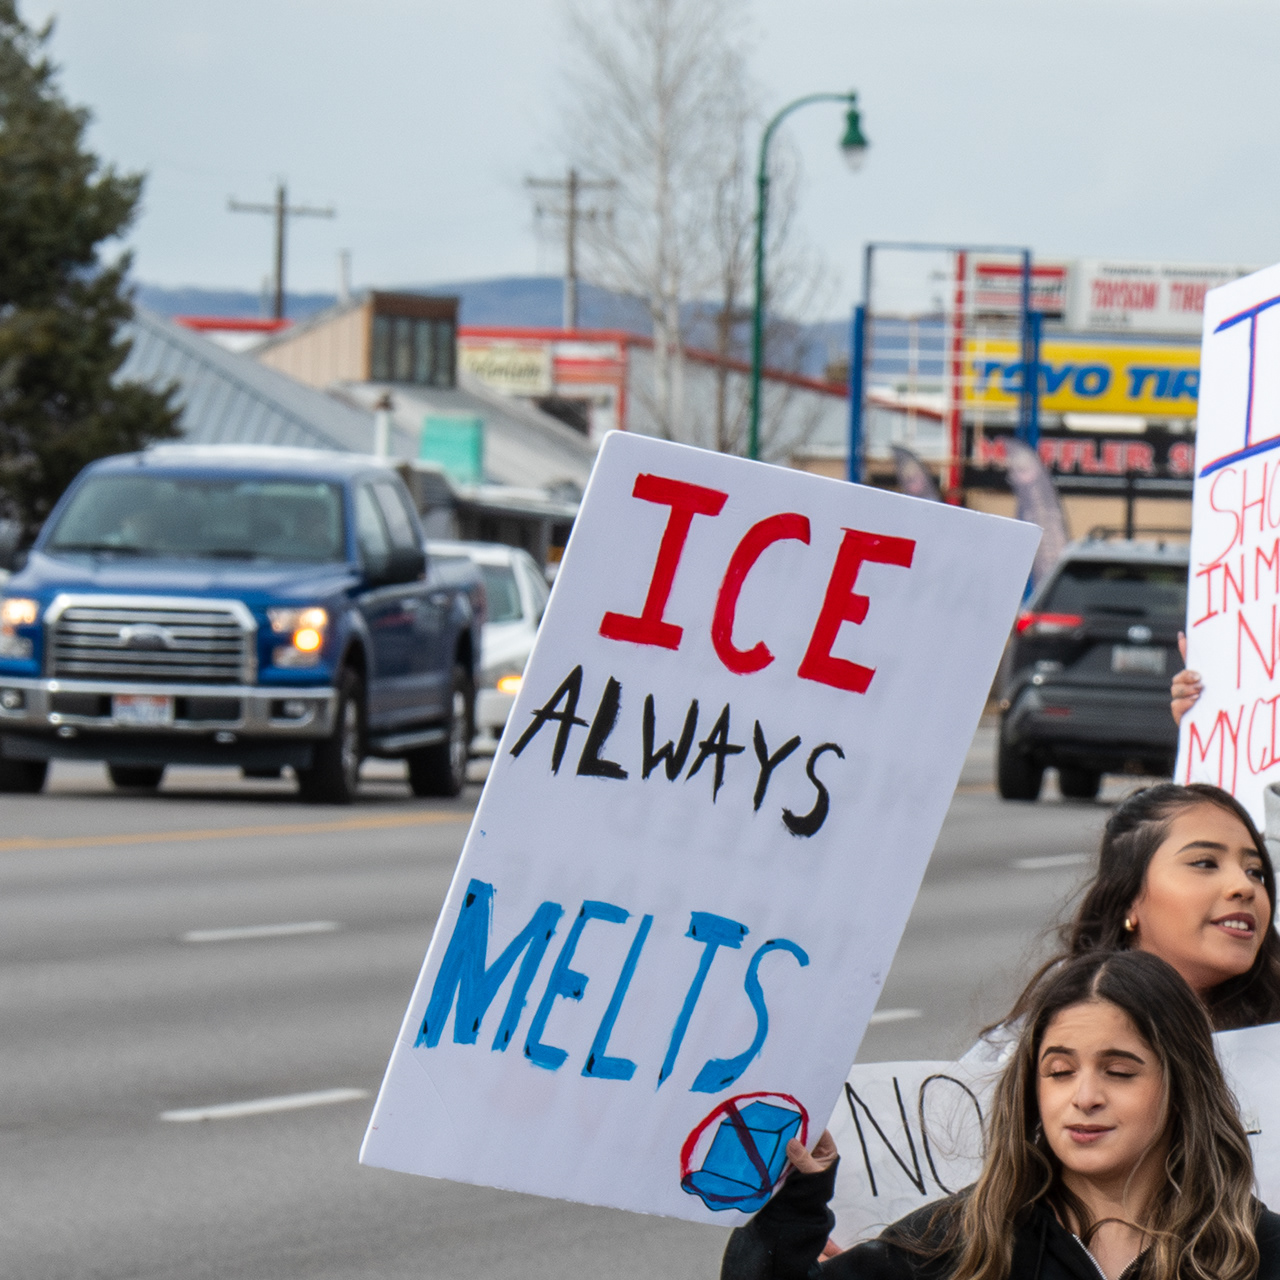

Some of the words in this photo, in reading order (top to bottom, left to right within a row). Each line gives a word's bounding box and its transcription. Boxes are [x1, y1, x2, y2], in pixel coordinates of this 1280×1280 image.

[976, 436, 1156, 476] MFFLER
[598, 472, 918, 694] ICE
[1192, 553, 1245, 628] IN
[508, 664, 846, 839] ALWAYS
[1185, 703, 1245, 797] MY
[412, 877, 810, 1094] MELTS
[843, 1072, 986, 1199] NO
